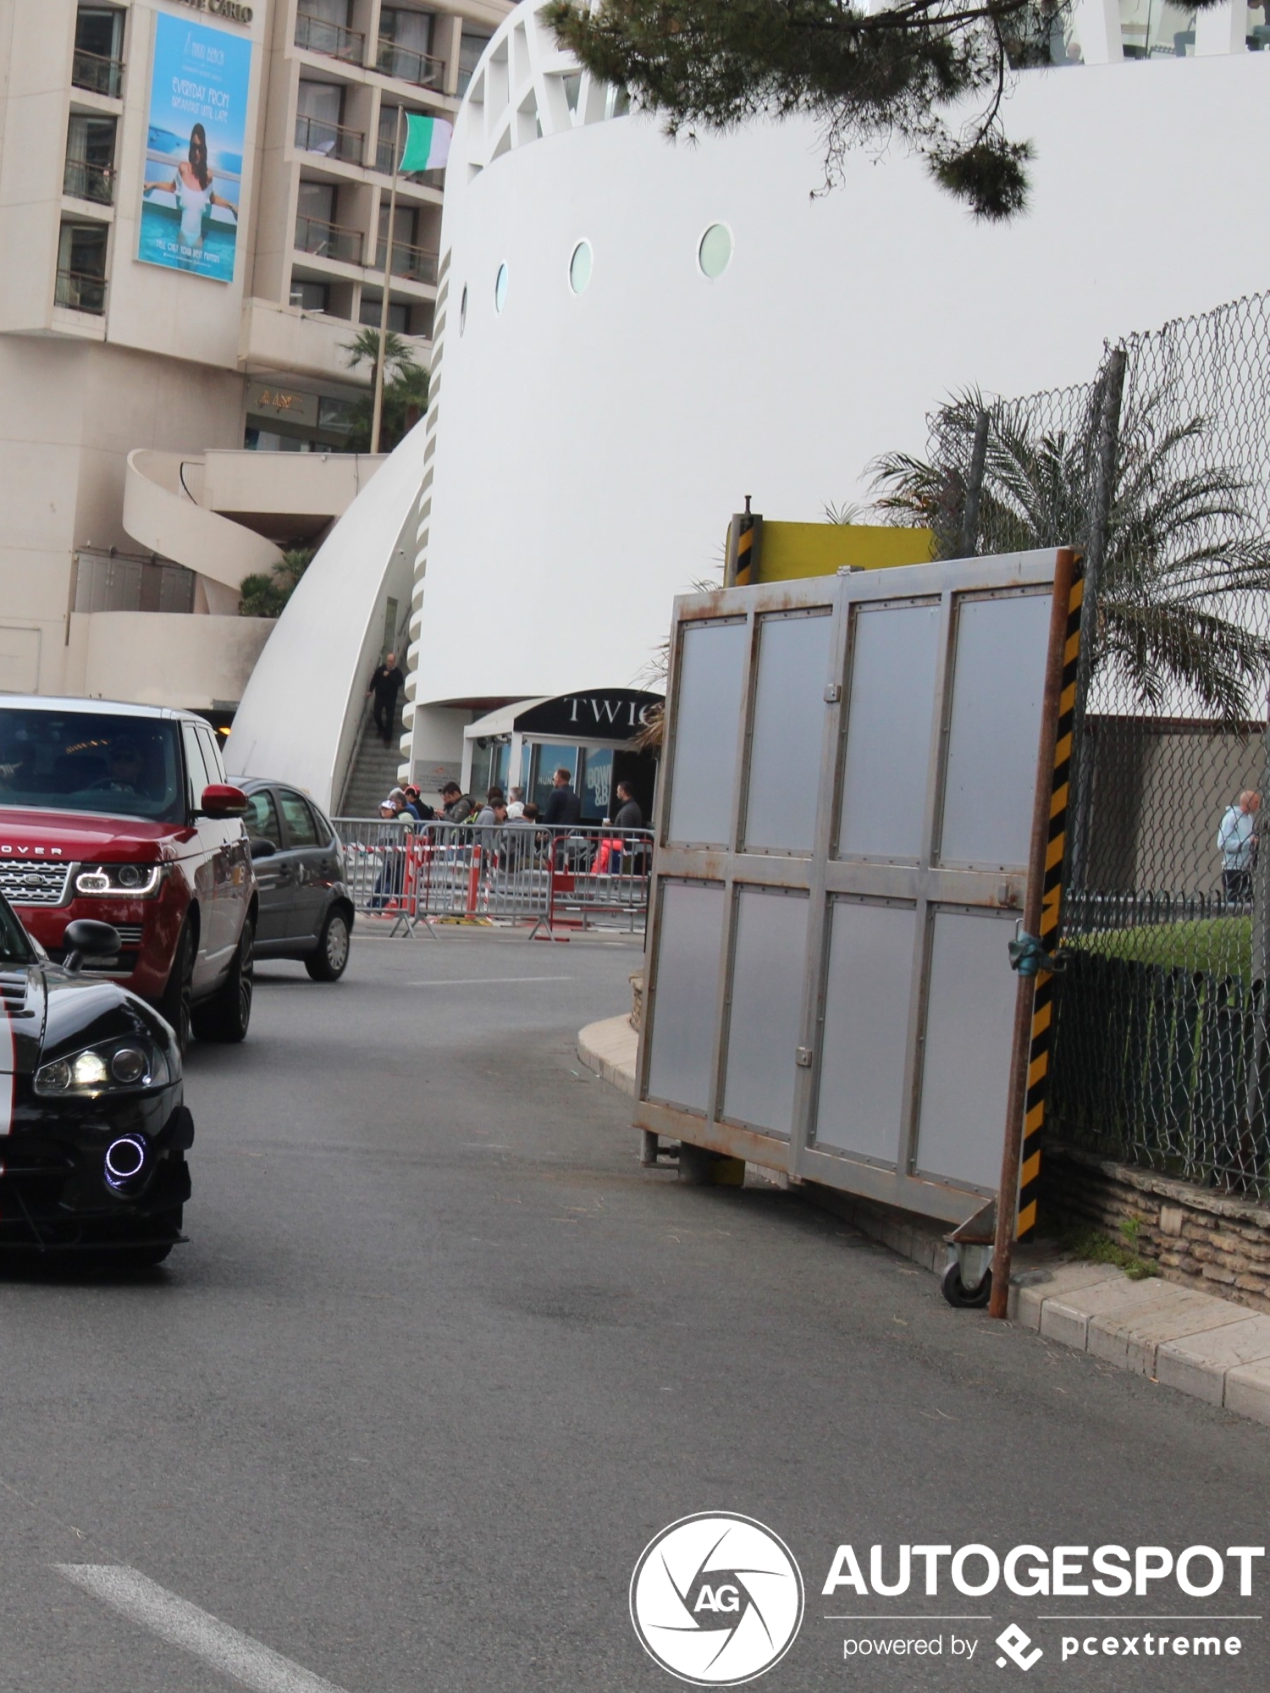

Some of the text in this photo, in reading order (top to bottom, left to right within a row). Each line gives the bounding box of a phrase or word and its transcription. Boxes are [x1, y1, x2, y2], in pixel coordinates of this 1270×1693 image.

[208, 0, 254, 23] CARLO
[172, 76, 230, 109] EVERYDAY FROM
